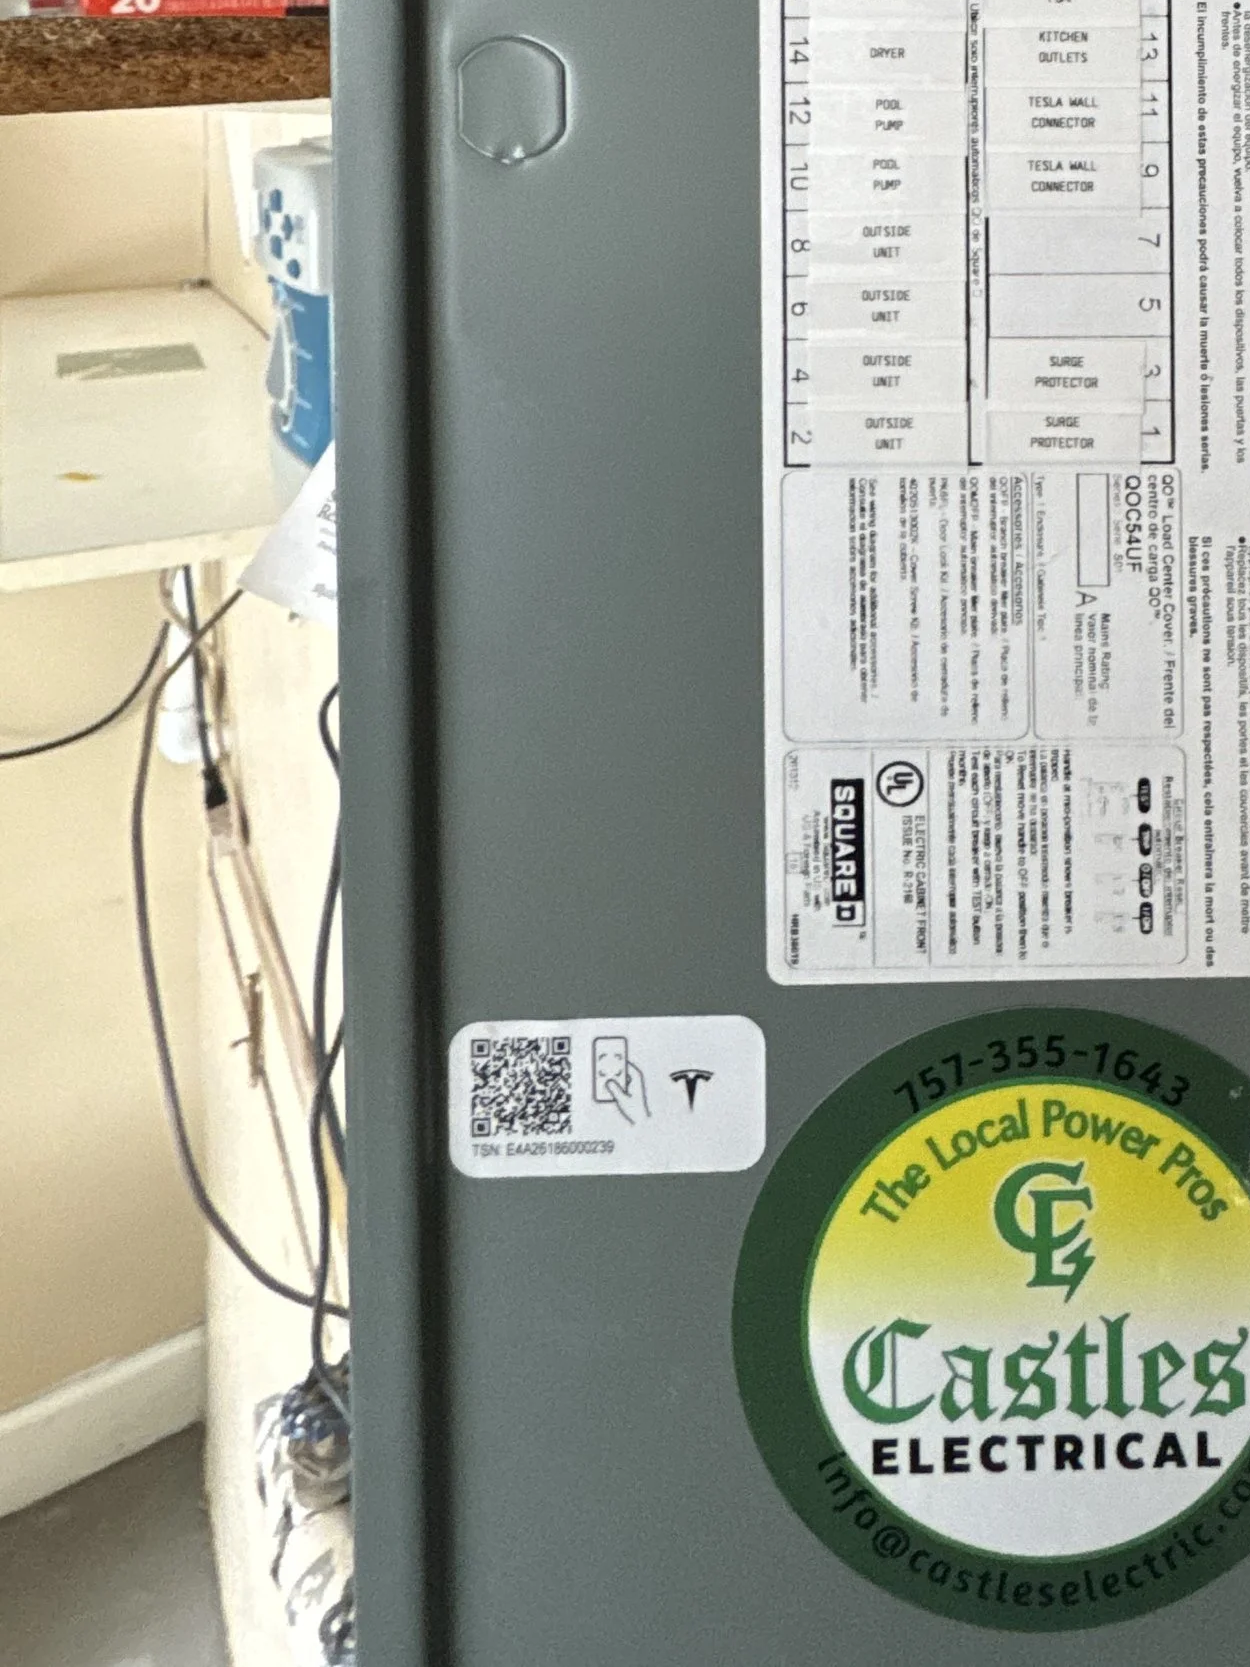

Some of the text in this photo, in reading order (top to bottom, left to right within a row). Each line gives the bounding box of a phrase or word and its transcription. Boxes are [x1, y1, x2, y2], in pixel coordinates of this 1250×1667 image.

[1039, 31, 1088, 42] KITCHEN
[871, 48, 905, 58] DRYER
[1039, 52, 1088, 63] OUTLETS
[876, 99, 901, 110] POOL
[1029, 96, 1096, 107] TESLA WALL
[790, 97, 811, 124] 12
[1032, 117, 1095, 128] CONNECTOR
[873, 159, 900, 170] POOL
[1028, 160, 1096, 171] TESLA WALL
[1032, 181, 1093, 192] CONNECTOR
[863, 226, 910, 237] OUTSIDE
[1139, 234, 1160, 247] 7
[874, 247, 900, 258] UNIT
[862, 290, 910, 301] OUTSIDE
[1139, 298, 1161, 311] 5
[872, 311, 899, 322] UNIT
[863, 355, 911, 366] OUTSIDE
[1050, 356, 1084, 367] SURGE
[873, 376, 899, 387] UNIT
[1035, 376, 1098, 388] PROTECTOR
[866, 417, 913, 429] OUTSIDE
[1046, 416, 1079, 427] SURGE
[876, 438, 901, 449] UNIT
[1031, 437, 1094, 449] PROTECTOR
[1125, 476, 1141, 571] QOC54UF
[830, 782, 861, 921] SQUARE D
[893, 1035, 1192, 1115] 757-355-1643
[860, 1098, 1228, 1226] The Local Power Pros
[843, 1313, 1248, 1426] Castles
[872, 1433, 1223, 1475] ELECTRICAL
